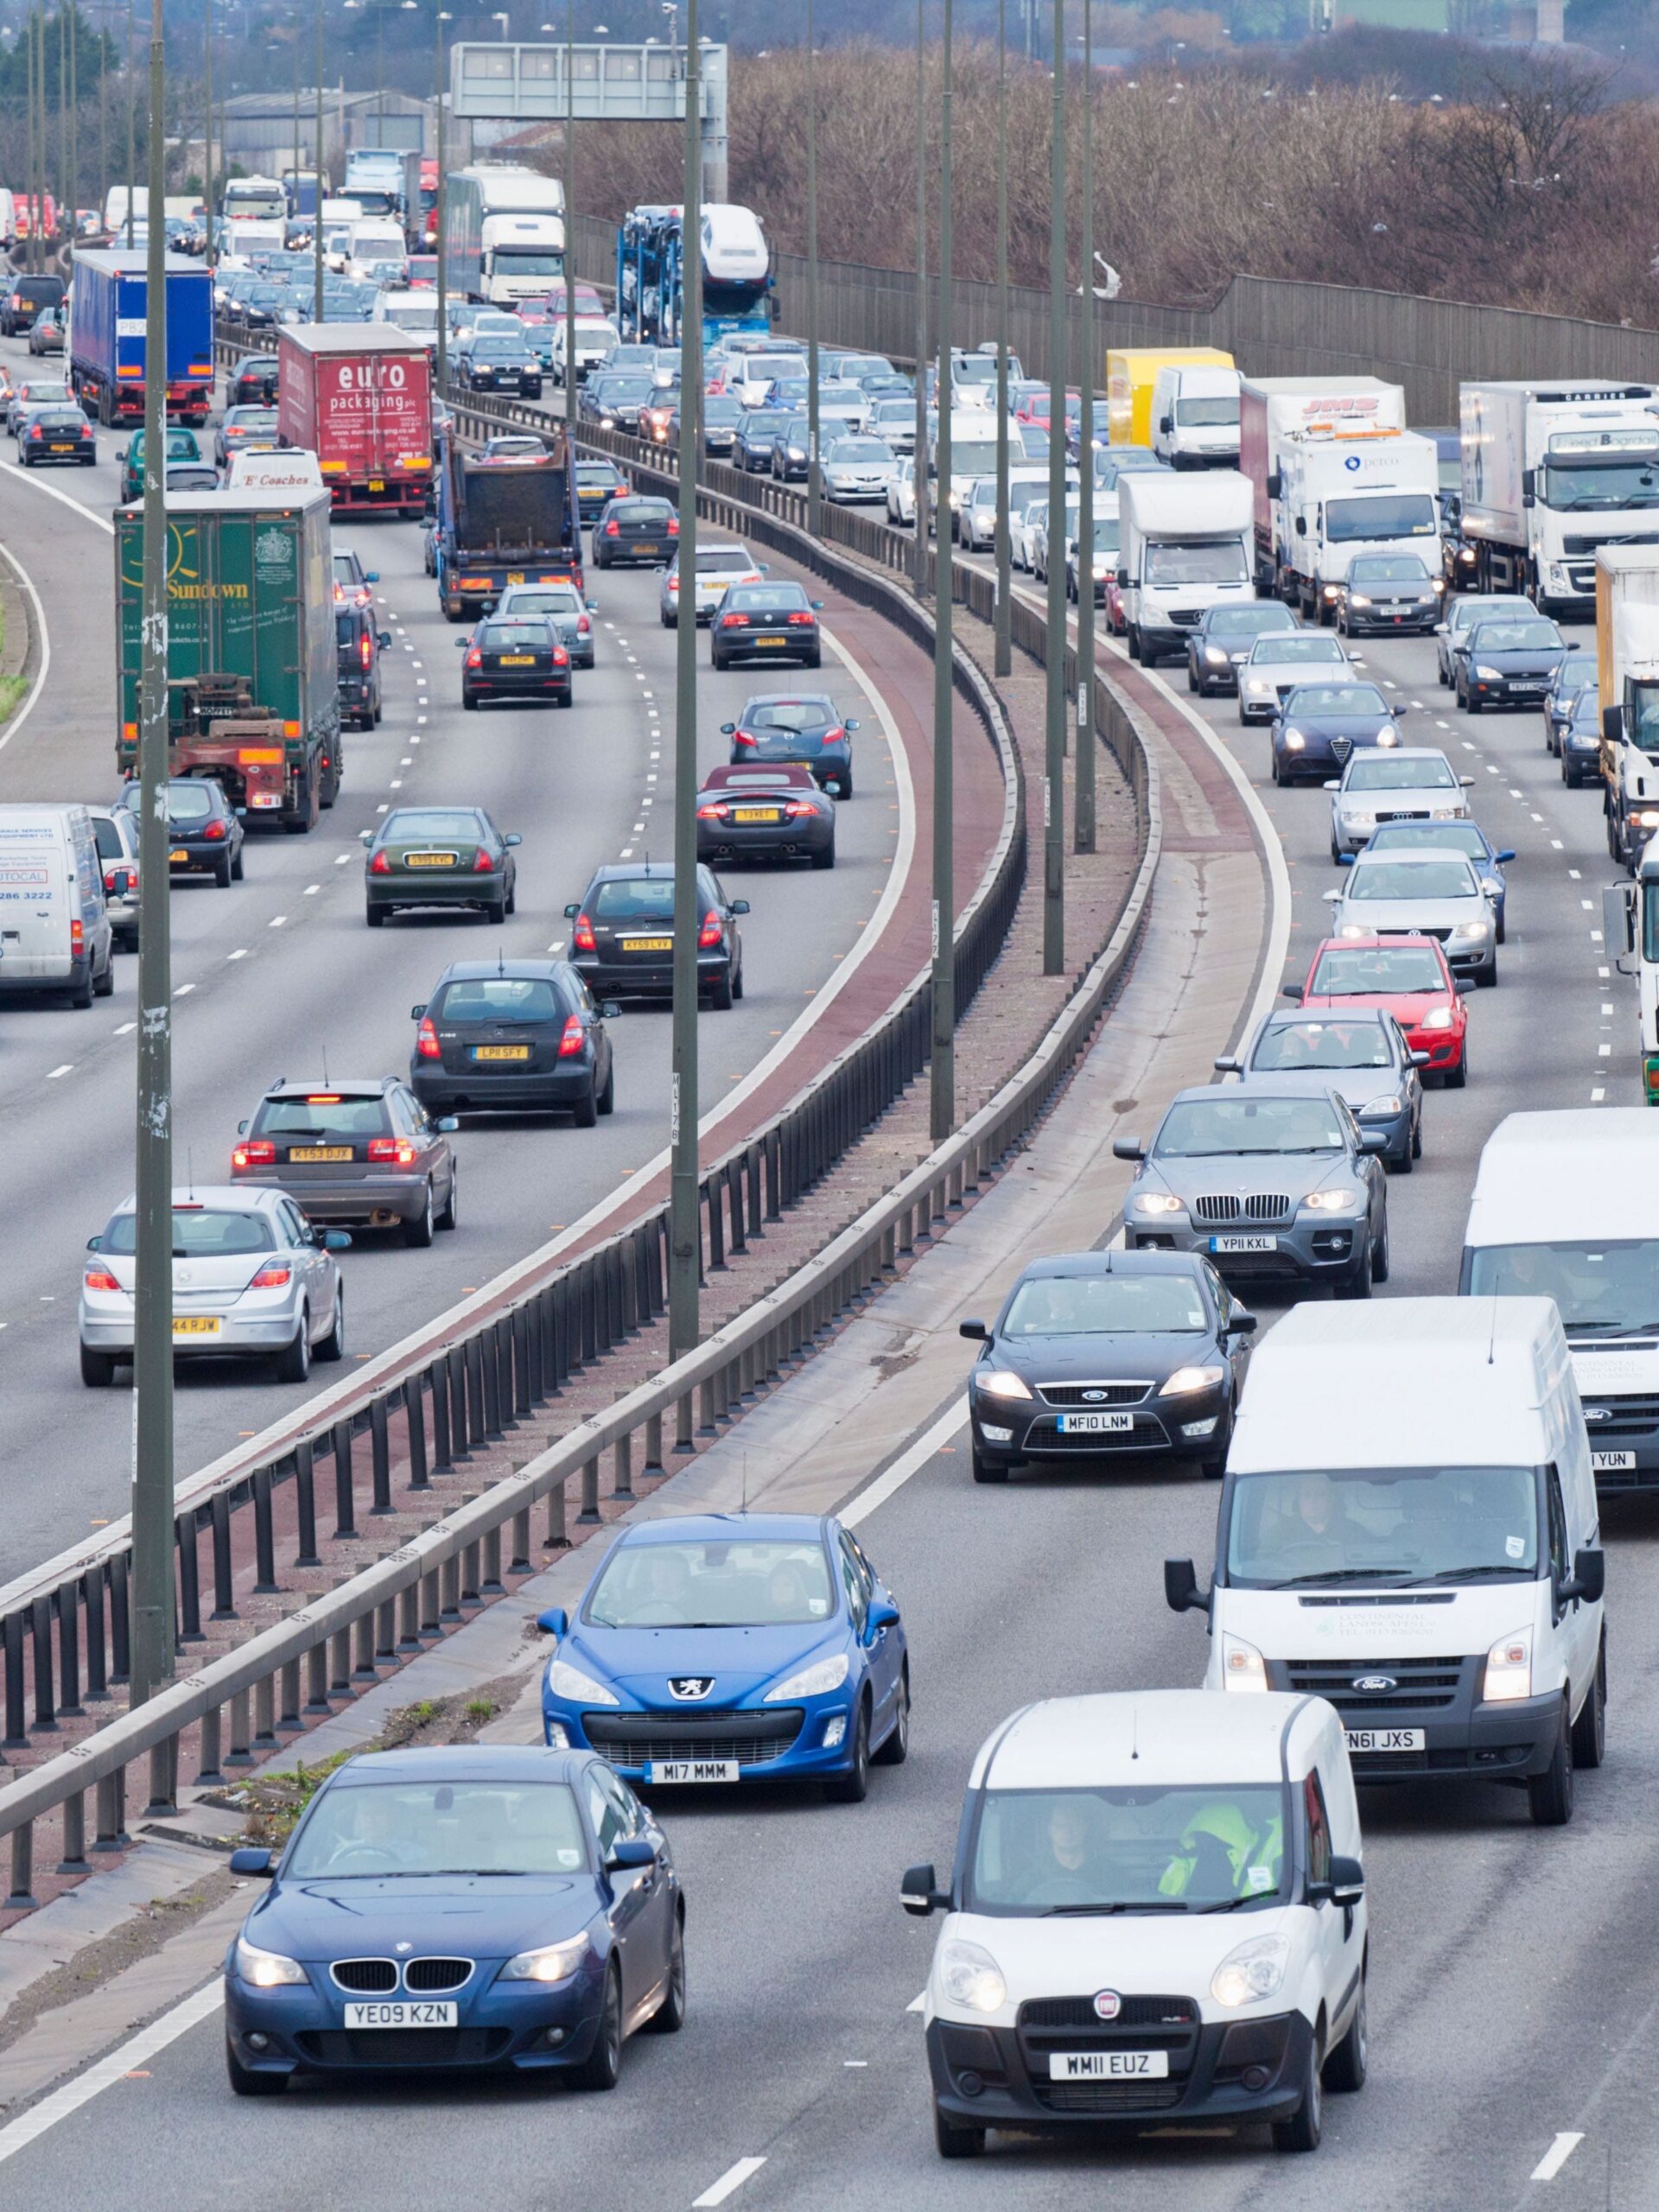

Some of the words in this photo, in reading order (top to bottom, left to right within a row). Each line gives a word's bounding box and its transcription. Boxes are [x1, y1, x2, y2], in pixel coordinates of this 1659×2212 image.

[339, 365, 404, 389] euro
[330, 393, 404, 412] packaging
[404, 399, 416, 408] plc
[1565, 392, 1626, 401] CARRIER
[1302, 397, 1379, 415] JMS
[259, 474, 309, 486] Coaches
[167, 578, 249, 599] Sundown
[626, 939, 649, 949] KY59
[651, 938, 668, 949] LVV
[482, 1047, 501, 1058] LP11
[503, 1046, 522, 1057] SFY
[295, 1149, 323, 1159] KT53
[1223, 1238, 1244, 1249] YP11
[1247, 1237, 1270, 1249] KXL
[191, 1319, 215, 1331] RJW
[1069, 1416, 1098, 1429] MF10
[1102, 1415, 1128, 1429] LNM
[1599, 1453, 1626, 1466] YUN
[1339, 1612, 1427, 1621] CONTINENTAL
[1339, 1620, 1419, 1629] LANDSCAPES
[1362, 1678, 1387, 1689] Ford
[1344, 1732, 1376, 1748] N61
[1381, 1732, 1414, 1747] JXS
[664, 1764, 690, 1780] M17
[694, 1764, 727, 1779] MMM
[354, 2005, 404, 2024] YE09
[410, 2005, 448, 2023] KZN
[1067, 2056, 1104, 2075] WM11
[1110, 2055, 1150, 2074] EUZ
